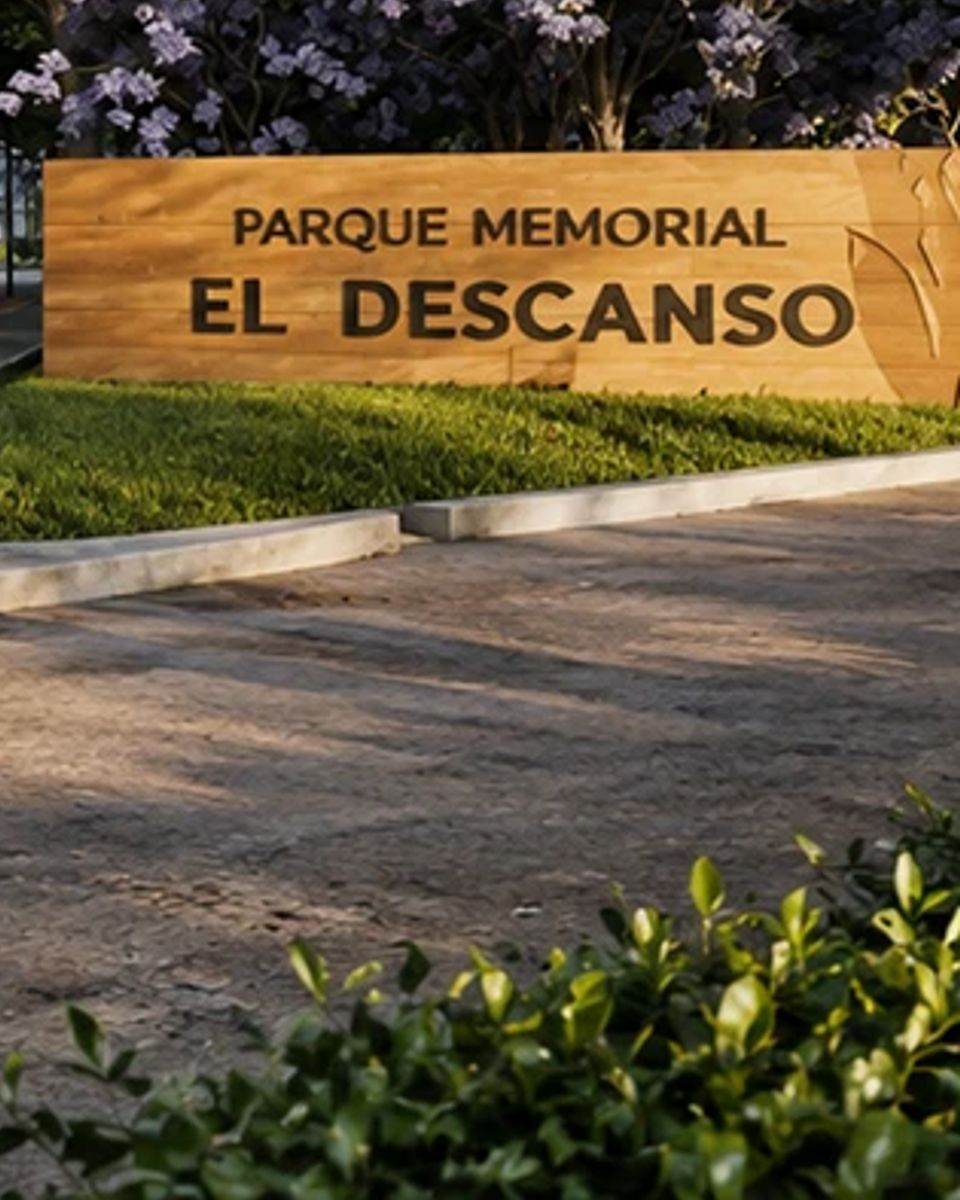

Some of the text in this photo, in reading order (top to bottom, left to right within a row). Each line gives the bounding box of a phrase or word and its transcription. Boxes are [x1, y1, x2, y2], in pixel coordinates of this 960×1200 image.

[234, 207, 786, 252] PARQUE MEMORIAL
[191, 277, 854, 346] EL DESCANSO
